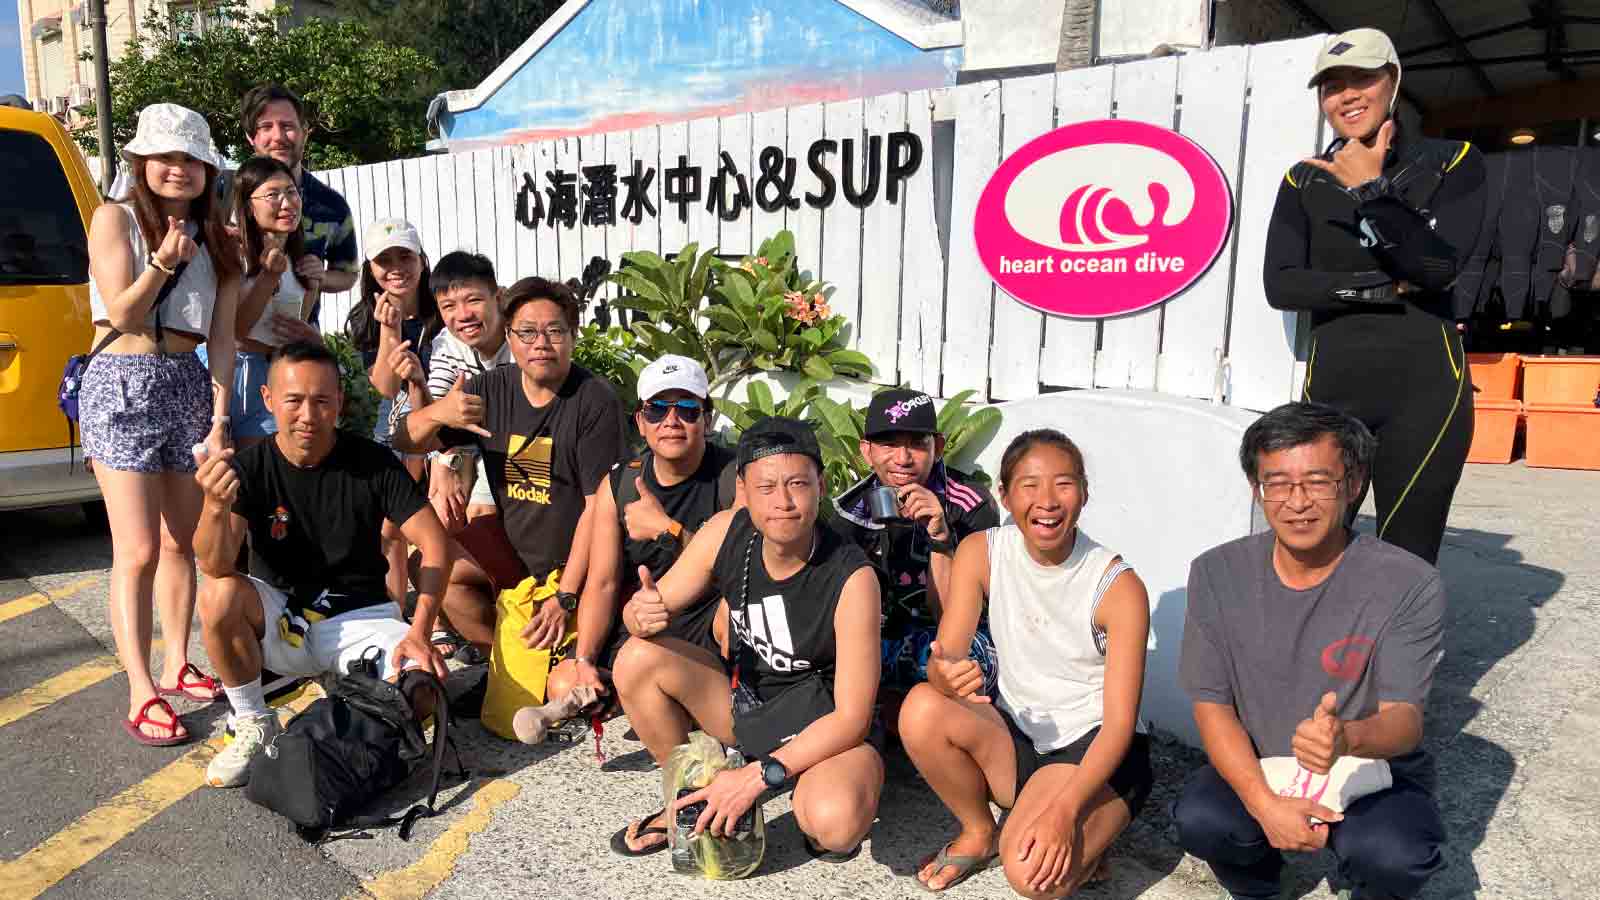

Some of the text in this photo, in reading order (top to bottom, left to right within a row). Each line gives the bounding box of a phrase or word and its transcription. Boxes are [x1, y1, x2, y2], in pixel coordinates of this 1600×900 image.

[1000, 252, 1185, 273] heart ocean dive
[507, 483, 552, 504] Kodak
